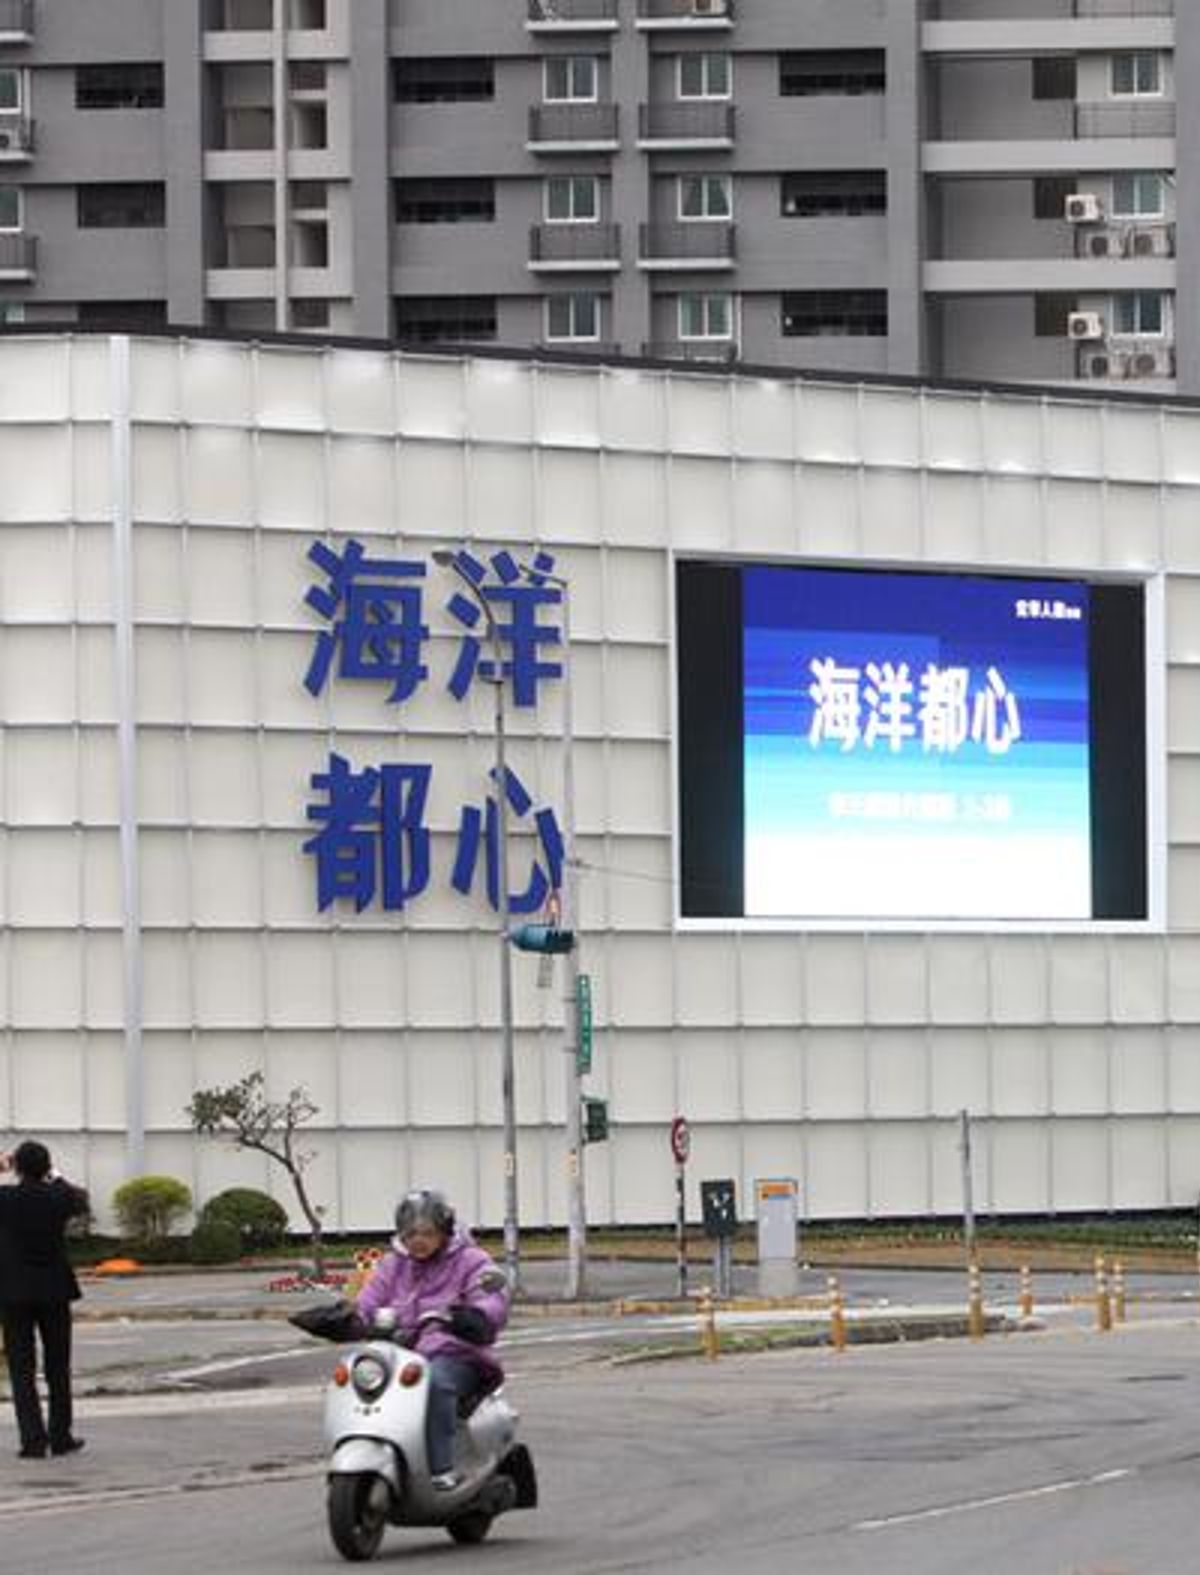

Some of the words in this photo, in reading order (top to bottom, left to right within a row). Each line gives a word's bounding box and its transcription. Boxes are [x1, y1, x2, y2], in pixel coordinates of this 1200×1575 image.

[303, 540, 562, 708] 海洋
[808, 657, 1022, 754] 海洋都心
[302, 752, 566, 914] 都心
